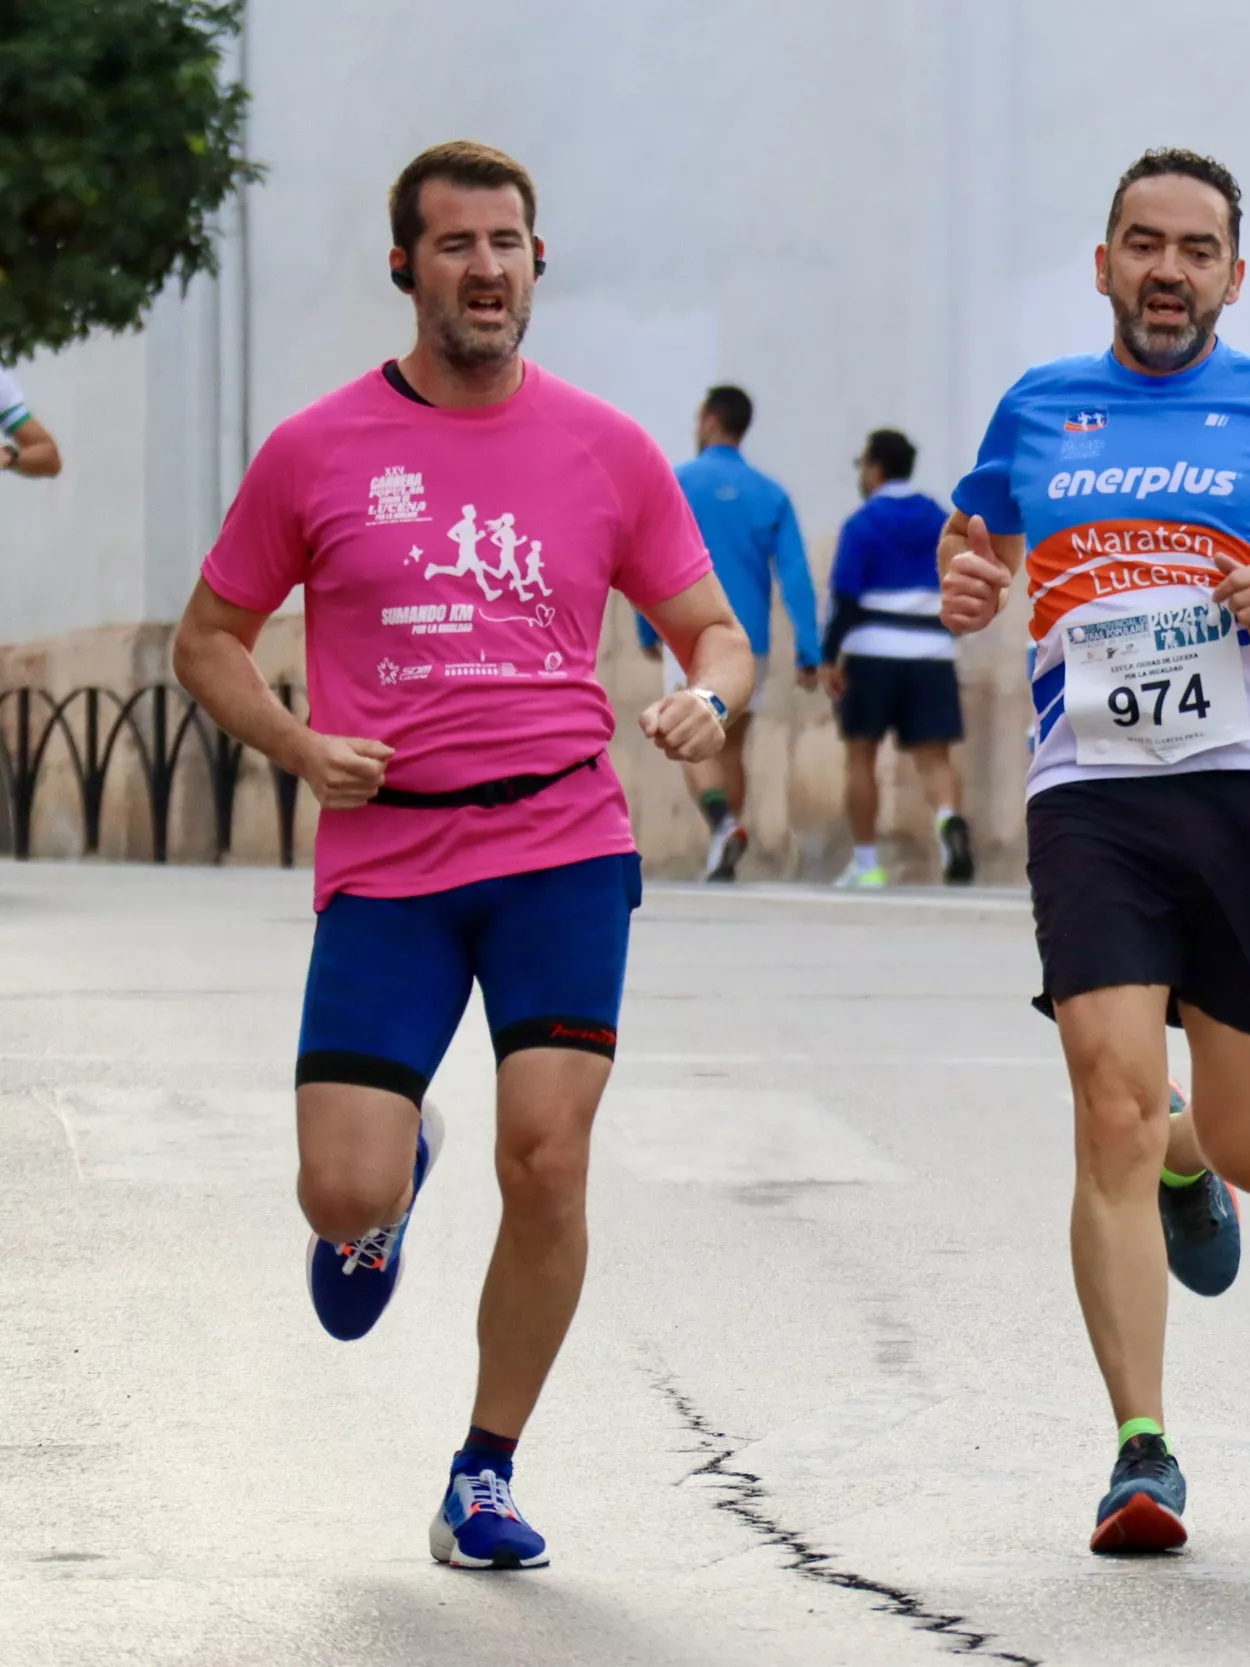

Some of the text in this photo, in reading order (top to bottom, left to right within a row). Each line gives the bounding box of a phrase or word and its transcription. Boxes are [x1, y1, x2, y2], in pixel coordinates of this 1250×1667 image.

[1048, 461, 1237, 500] enerplus
[1071, 524, 1214, 560] Maratón
[1089, 565, 1211, 596] Lucena
[381, 603, 475, 626] SUMANDO KM
[1150, 605, 1197, 631] 2024
[1136, 659, 1161, 669] CIUDAD
[1162, 657, 1171, 665] DE
[1107, 673, 1211, 728] 974
